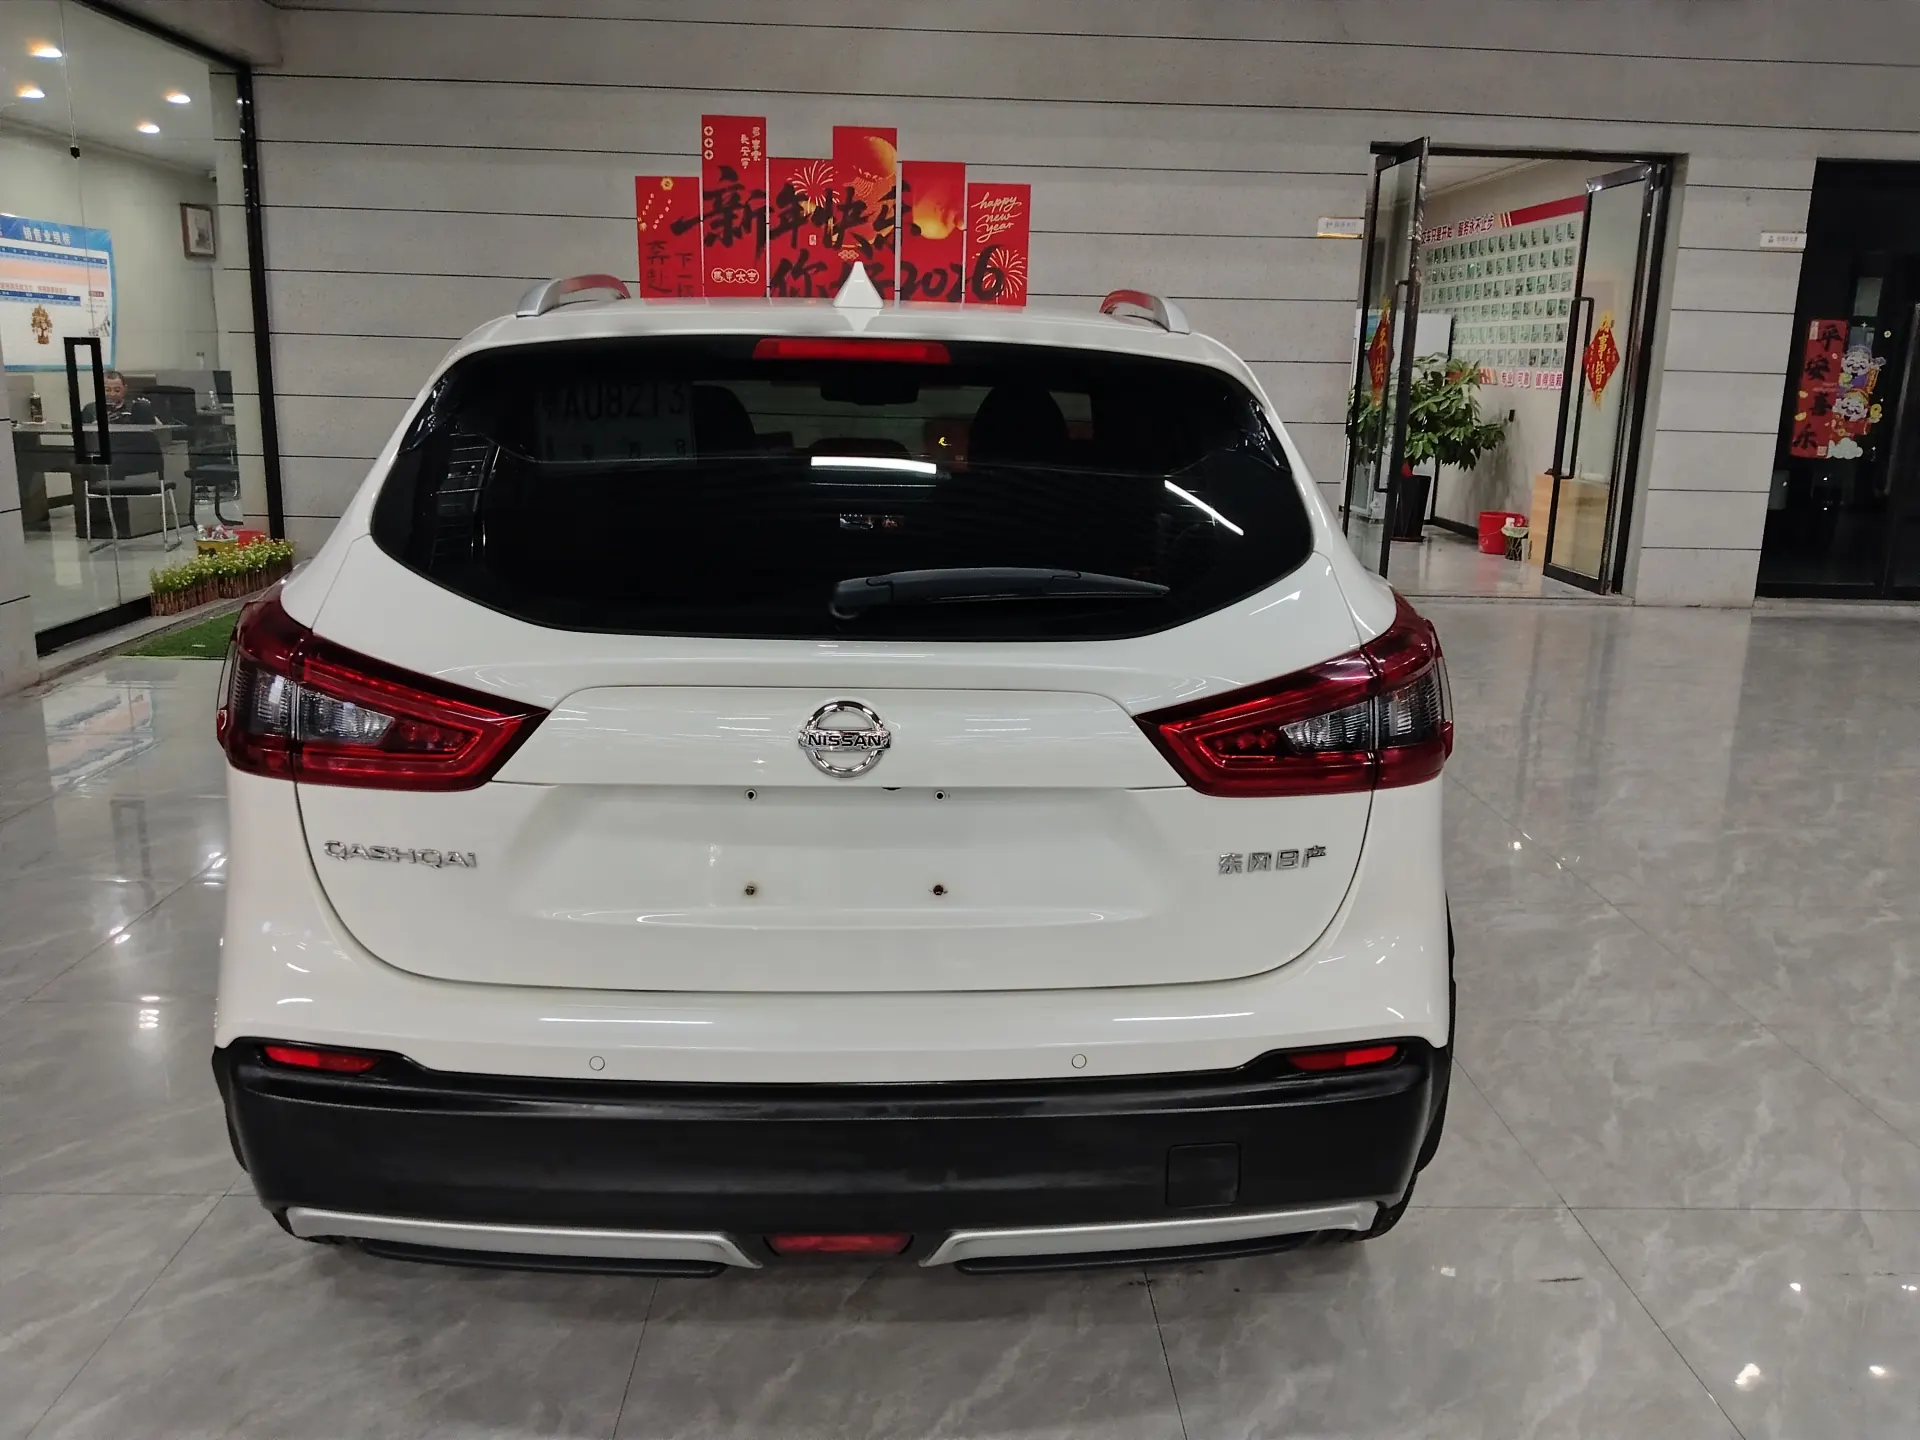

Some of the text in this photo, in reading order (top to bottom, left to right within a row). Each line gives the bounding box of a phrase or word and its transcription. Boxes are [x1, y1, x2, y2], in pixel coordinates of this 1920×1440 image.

[671, 165, 922, 262] 新年快乐
[971, 192, 1022, 214] happy
[976, 212, 1022, 224] new
[1457, 211, 1495, 238] 服务永不止步
[975, 222, 1015, 243] year
[807, 733, 883, 748] NISSAN
[324, 840, 478, 869] QASHQAI
[1219, 844, 1327, 875] 东风日产
